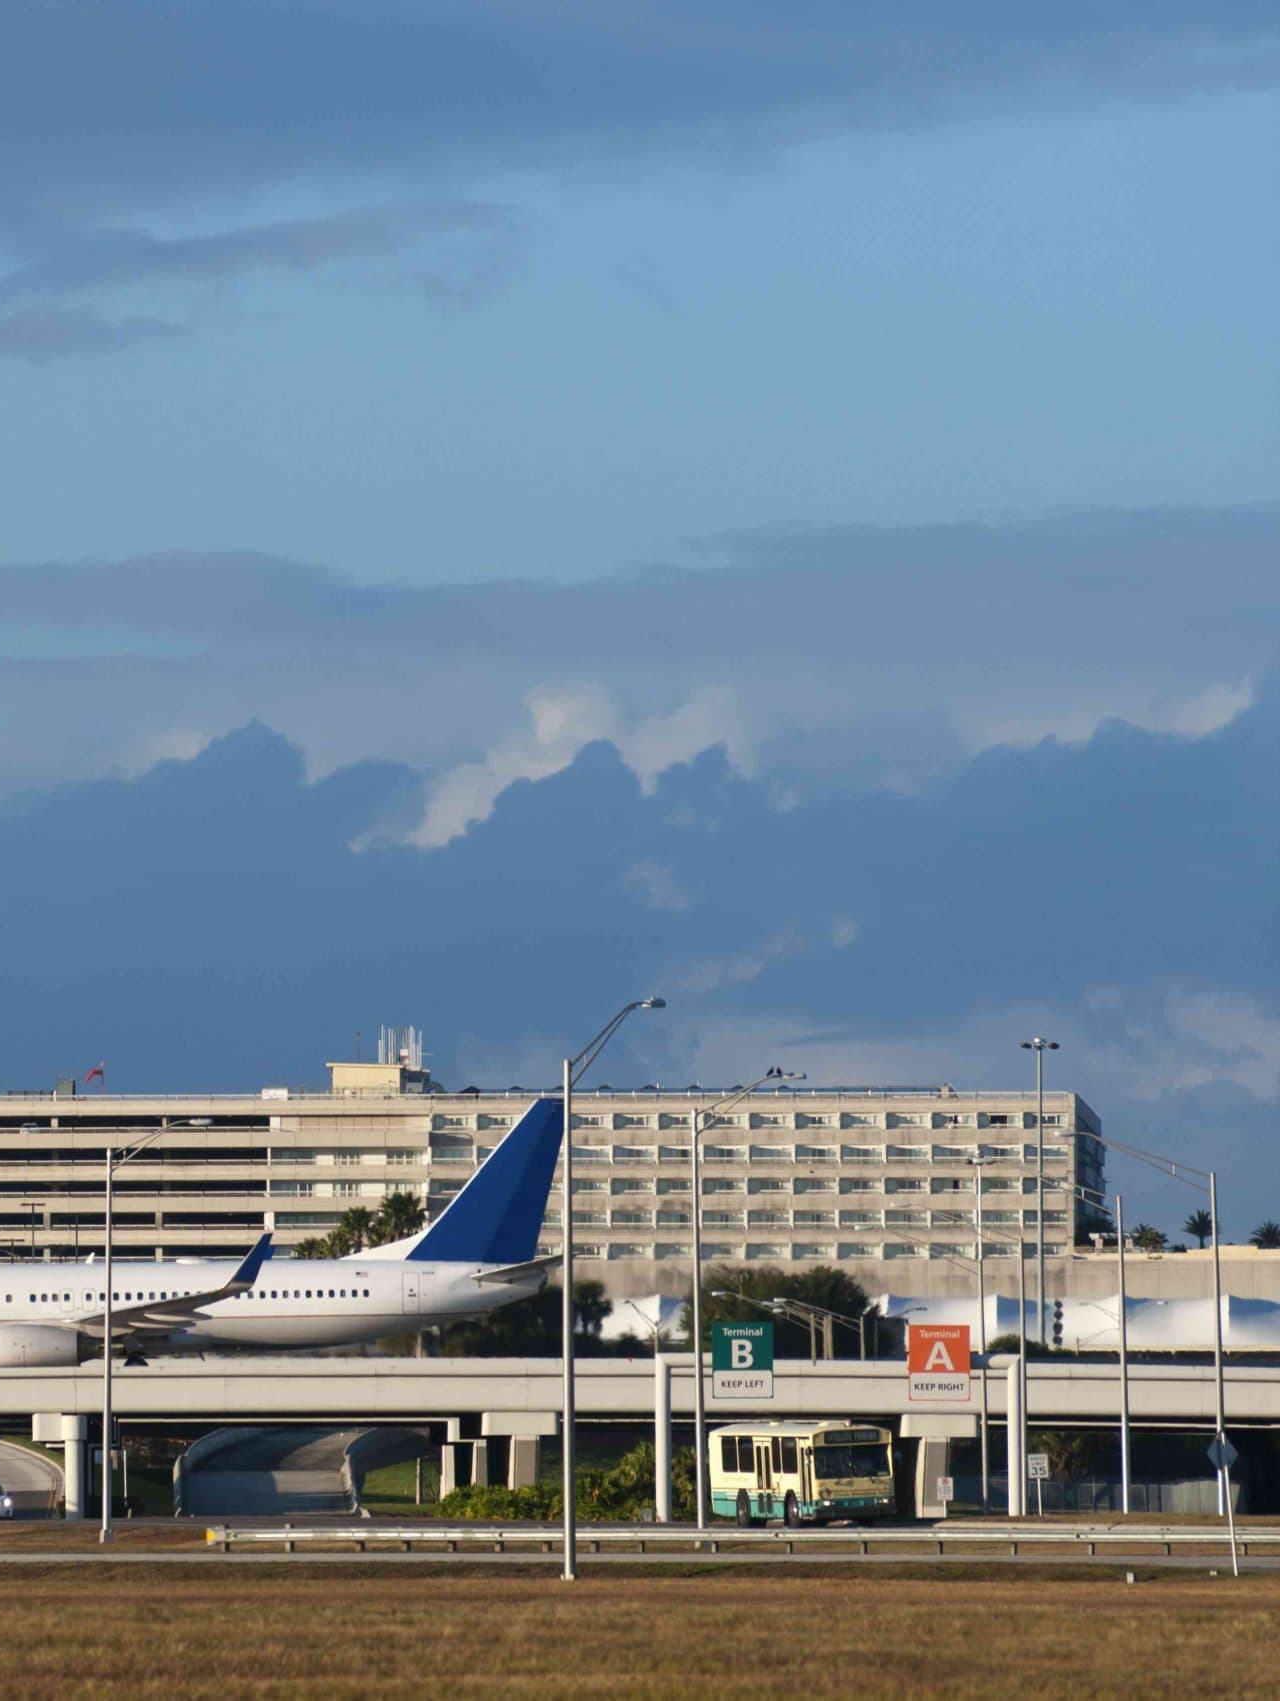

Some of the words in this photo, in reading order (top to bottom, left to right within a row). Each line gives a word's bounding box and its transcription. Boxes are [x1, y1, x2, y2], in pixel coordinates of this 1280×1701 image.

[722, 1327, 763, 1337] Terminal
[919, 1330, 960, 1339] Terminal
[731, 1339, 754, 1368] B
[924, 1341, 955, 1371] A
[721, 1380, 743, 1388] KEEP
[745, 1380, 764, 1388] LEFT
[914, 1383, 936, 1391] KEEP
[938, 1383, 965, 1391] RIGHT
[1031, 1466, 1046, 1476] 35
